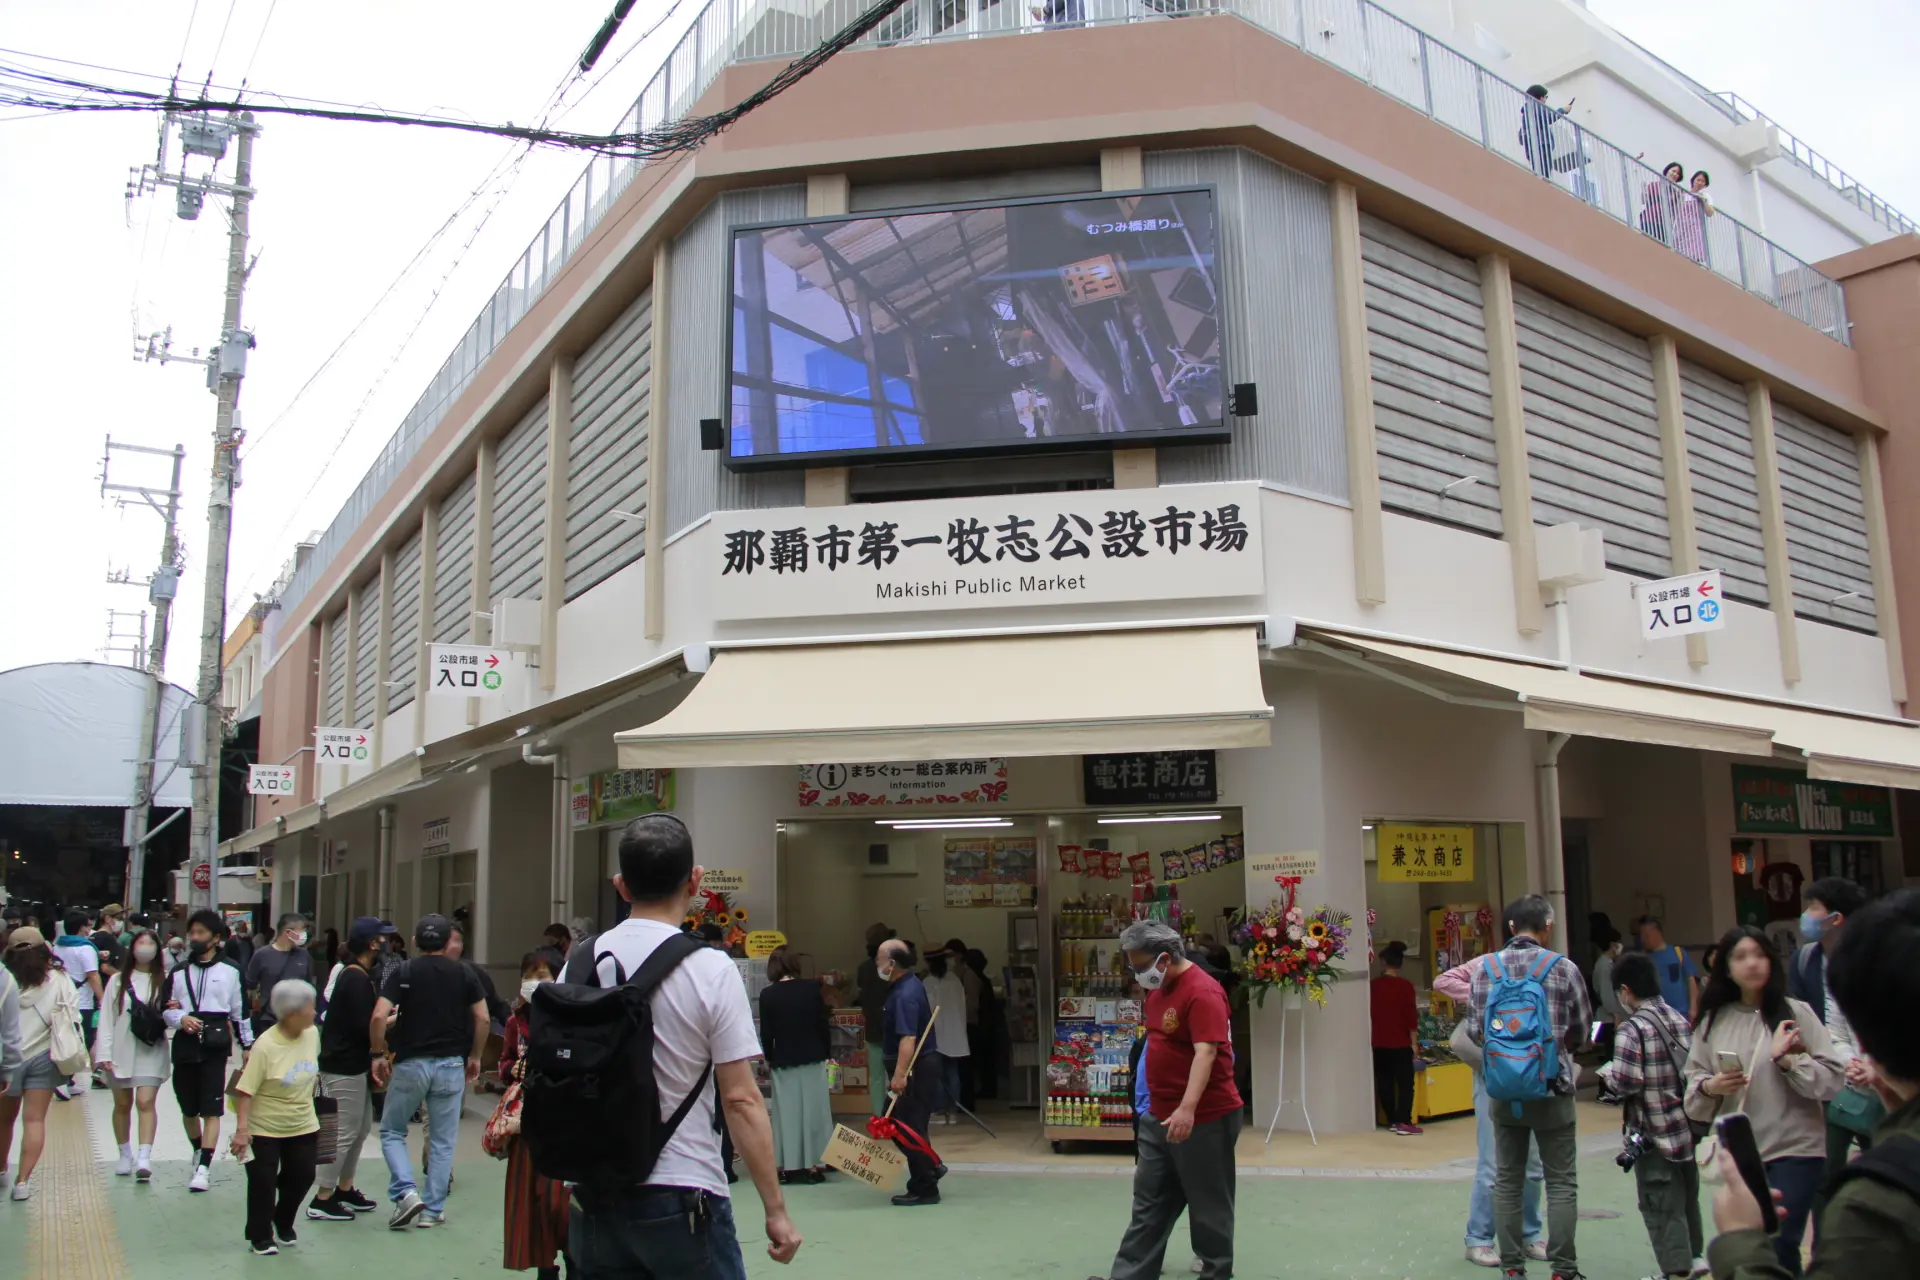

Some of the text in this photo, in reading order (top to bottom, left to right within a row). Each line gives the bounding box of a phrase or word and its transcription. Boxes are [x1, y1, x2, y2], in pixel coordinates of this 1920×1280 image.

[721, 503, 1248, 576] 那覇市第一牧志公設市場
[876, 573, 1086, 599] Makishi Public Market
[1648, 586, 1690, 603] 公設市場
[1649, 602, 1717, 630] 入口 北
[439, 654, 478, 665] 公設市場
[437, 669, 477, 687] 入口
[323, 735, 352, 743] 公設市場
[321, 745, 350, 758] 入口
[1093, 756, 1209, 789] 電柱商店
[254, 779, 278, 789] 入口
[1391, 845, 1463, 867] 兼次商店
